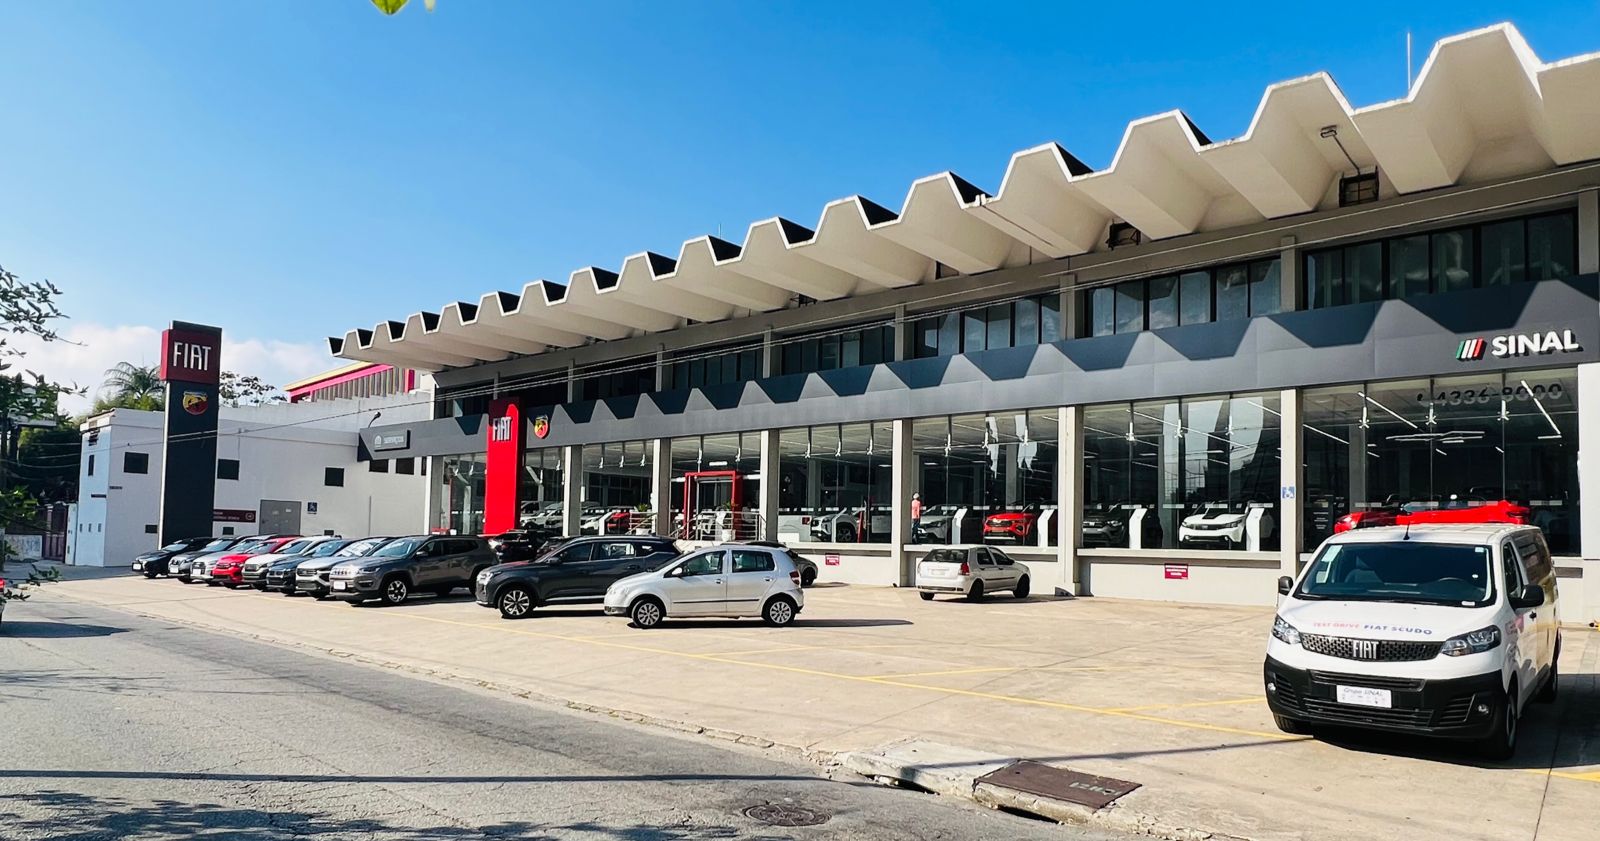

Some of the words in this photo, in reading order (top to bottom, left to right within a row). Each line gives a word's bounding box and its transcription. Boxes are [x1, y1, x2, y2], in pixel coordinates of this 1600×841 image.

[1491, 330, 1579, 356] SINAL
[173, 341, 212, 371] FIAT
[1436, 383, 1562, 406] 4336-8000
[492, 416, 512, 441] FIAT
[1391, 627, 1433, 635] SCUDO
[1352, 640, 1380, 659] FIAT
